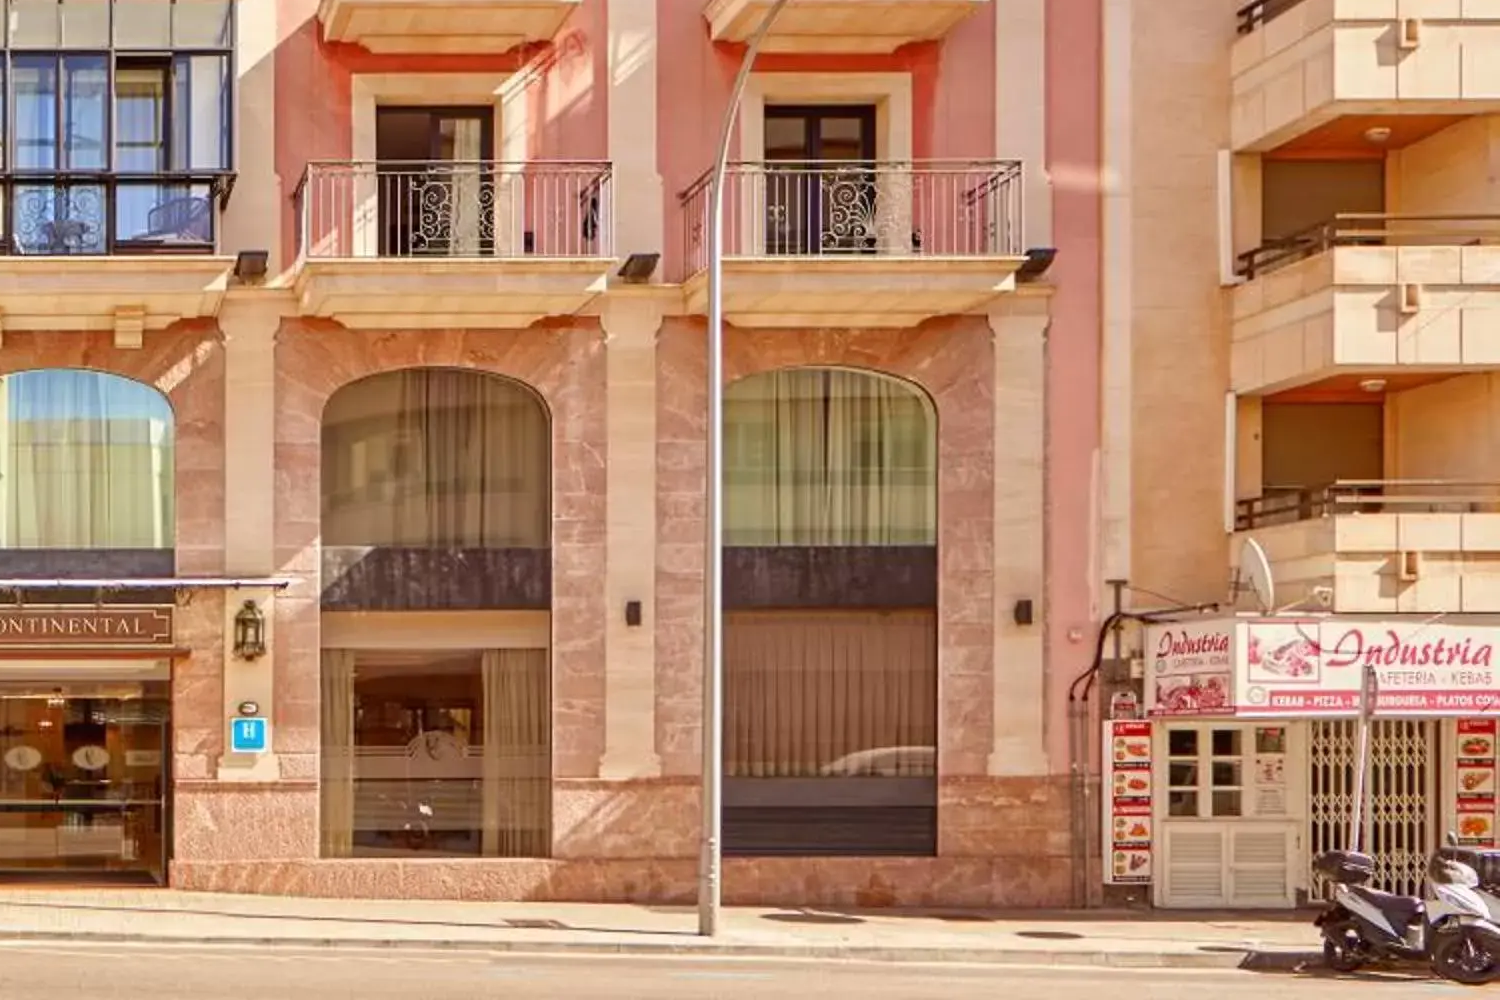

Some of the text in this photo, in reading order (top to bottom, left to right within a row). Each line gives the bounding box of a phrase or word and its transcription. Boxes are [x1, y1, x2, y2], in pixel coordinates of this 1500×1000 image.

[1156, 630, 1230, 658] Industria
[1326, 628, 1493, 667] Industria
[1378, 671, 1437, 686] AFETERIA
[243, 721, 257, 739] H
